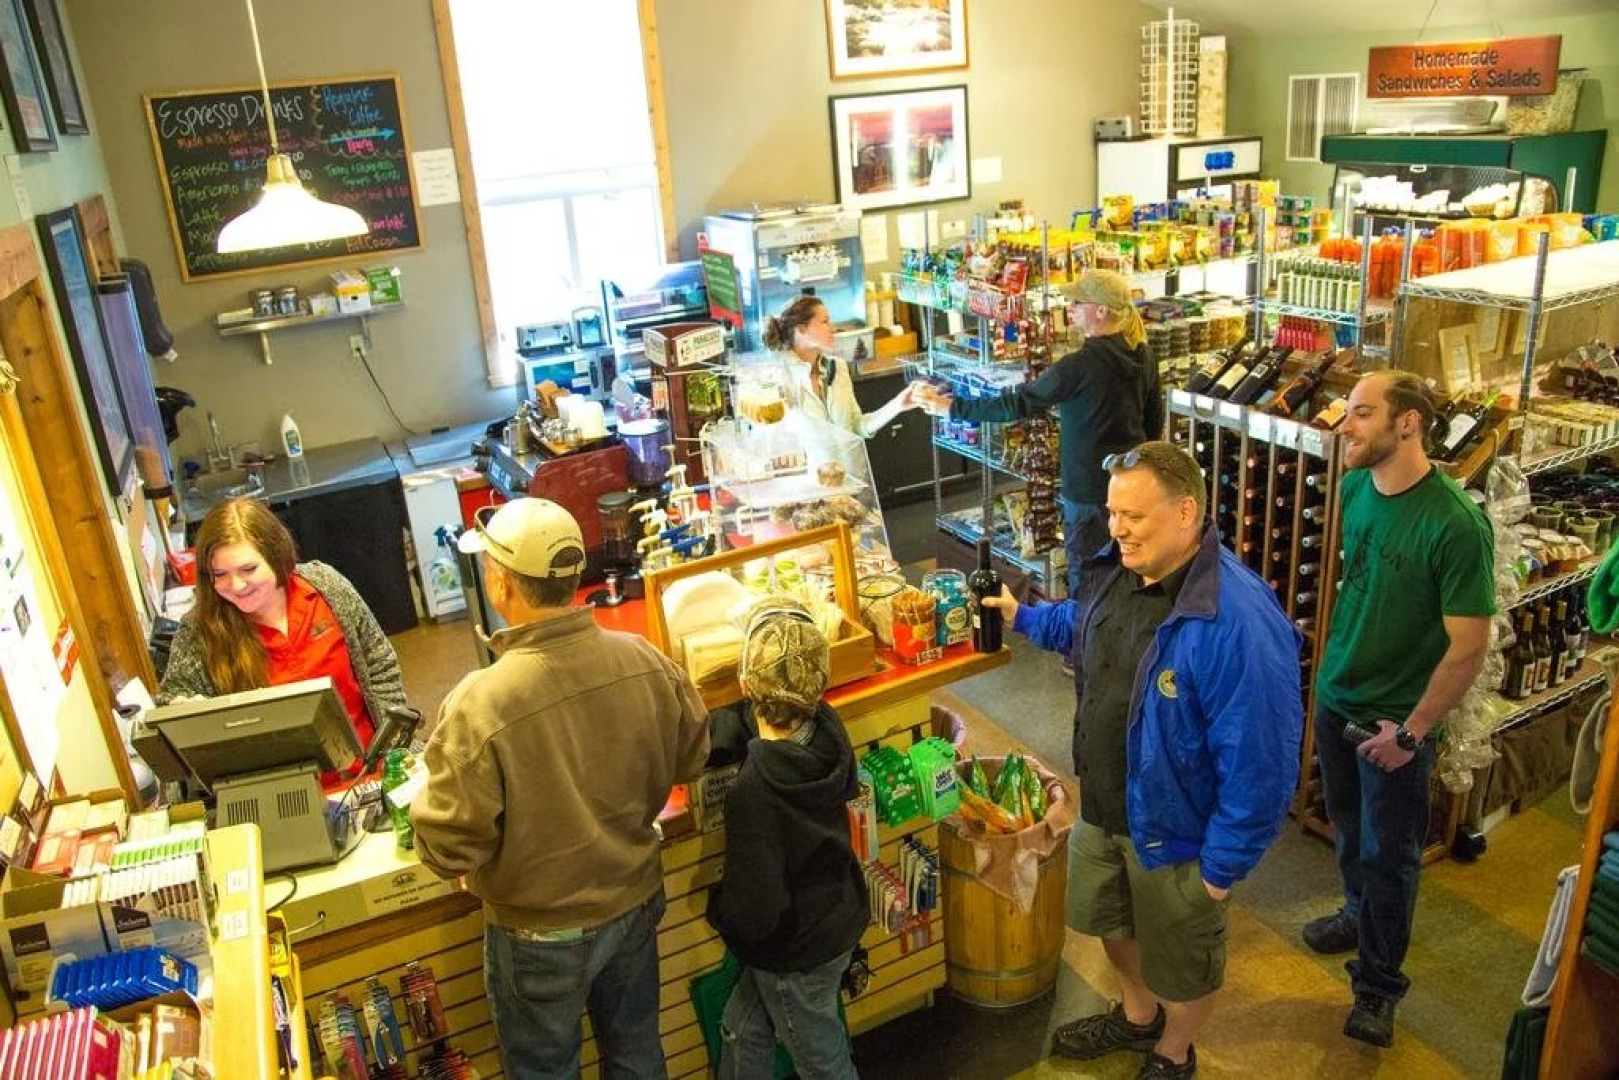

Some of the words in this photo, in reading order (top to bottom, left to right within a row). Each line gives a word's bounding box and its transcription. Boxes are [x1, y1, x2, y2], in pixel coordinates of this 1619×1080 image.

[1413, 49, 1499, 70] Homemade
[1377, 71, 1463, 93] Sandwiches
[1469, 70, 1481, 89] &
[1486, 67, 1541, 89] Salads
[158, 100, 238, 139] Espresso
[241, 95, 304, 126] Drnks
